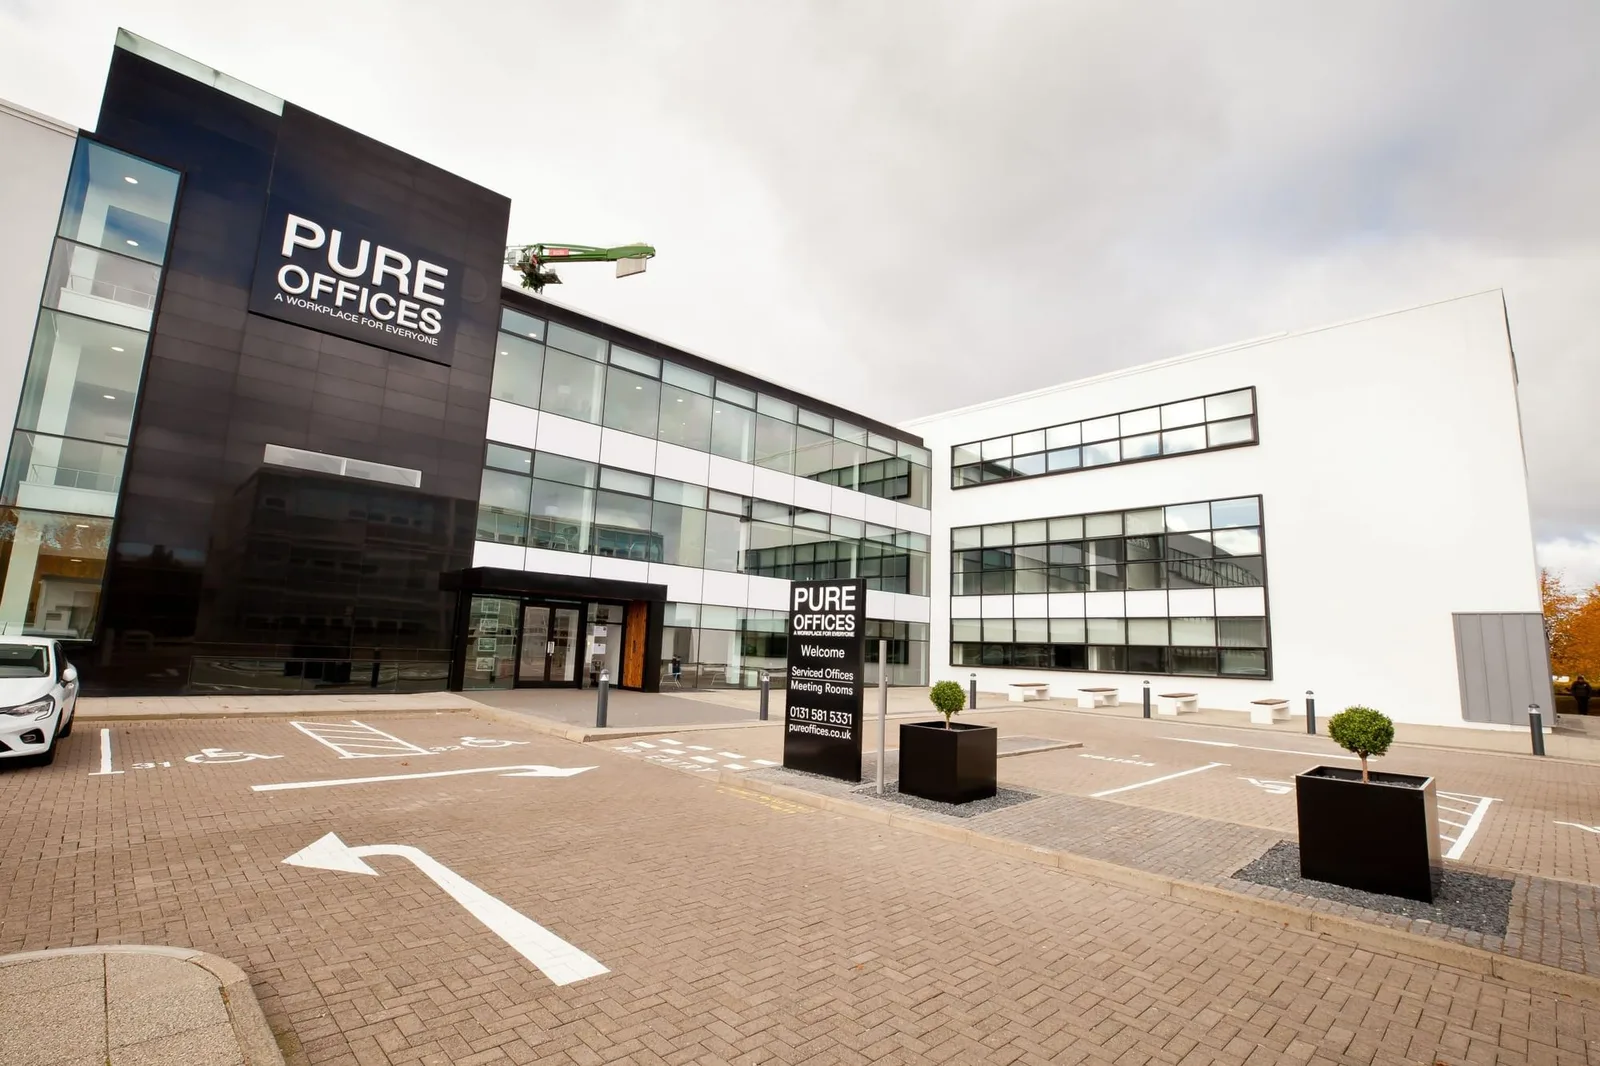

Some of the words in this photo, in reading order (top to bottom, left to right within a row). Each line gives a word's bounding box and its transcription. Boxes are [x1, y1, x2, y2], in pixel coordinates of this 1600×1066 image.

[281, 213, 449, 306] PURE
[277, 264, 442, 335] OFFICES
[274, 293, 283, 302] A
[286, 295, 359, 323] WORKPLACE
[361, 317, 383, 330] FOR
[385, 324, 438, 346] EVERYONE
[794, 585, 856, 611] PURE
[793, 614, 855, 631] OFFICES
[801, 644, 845, 658] Welcome
[791, 665, 823, 678] Serviced
[824, 668, 854, 681] Offices
[790, 680, 823, 694] Meeting
[825, 683, 853, 695] Rooms
[790, 706, 809, 719] 0131
[811, 708, 827, 721] 581
[829, 710, 852, 725] 5331
[788, 723, 852, 740] pureoffices.co.uk
